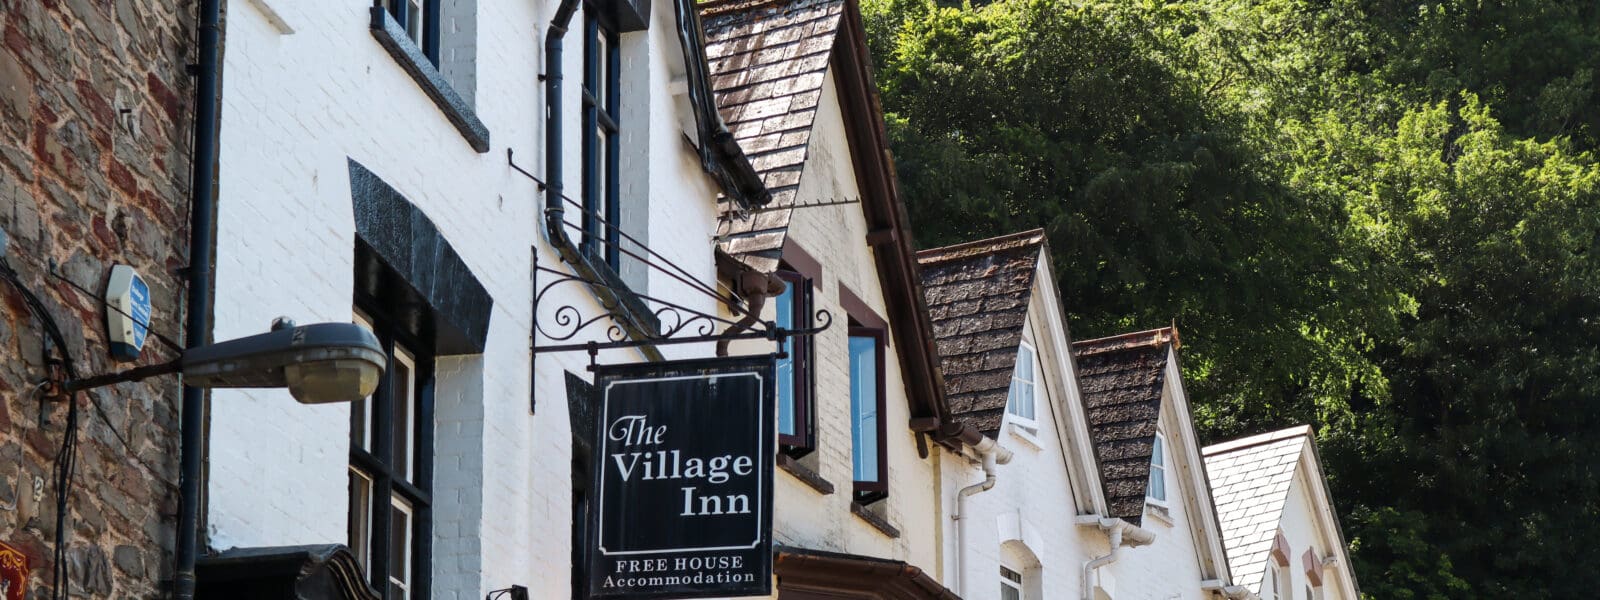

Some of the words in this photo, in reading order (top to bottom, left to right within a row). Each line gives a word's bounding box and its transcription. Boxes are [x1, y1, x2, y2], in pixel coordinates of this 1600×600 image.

[609, 415, 666, 446] The
[611, 450, 752, 483] Village
[680, 487, 751, 516] Inn
[616, 559, 667, 572] FREE
[675, 556, 742, 570] HOUSE
[603, 571, 753, 587] Accommodation
